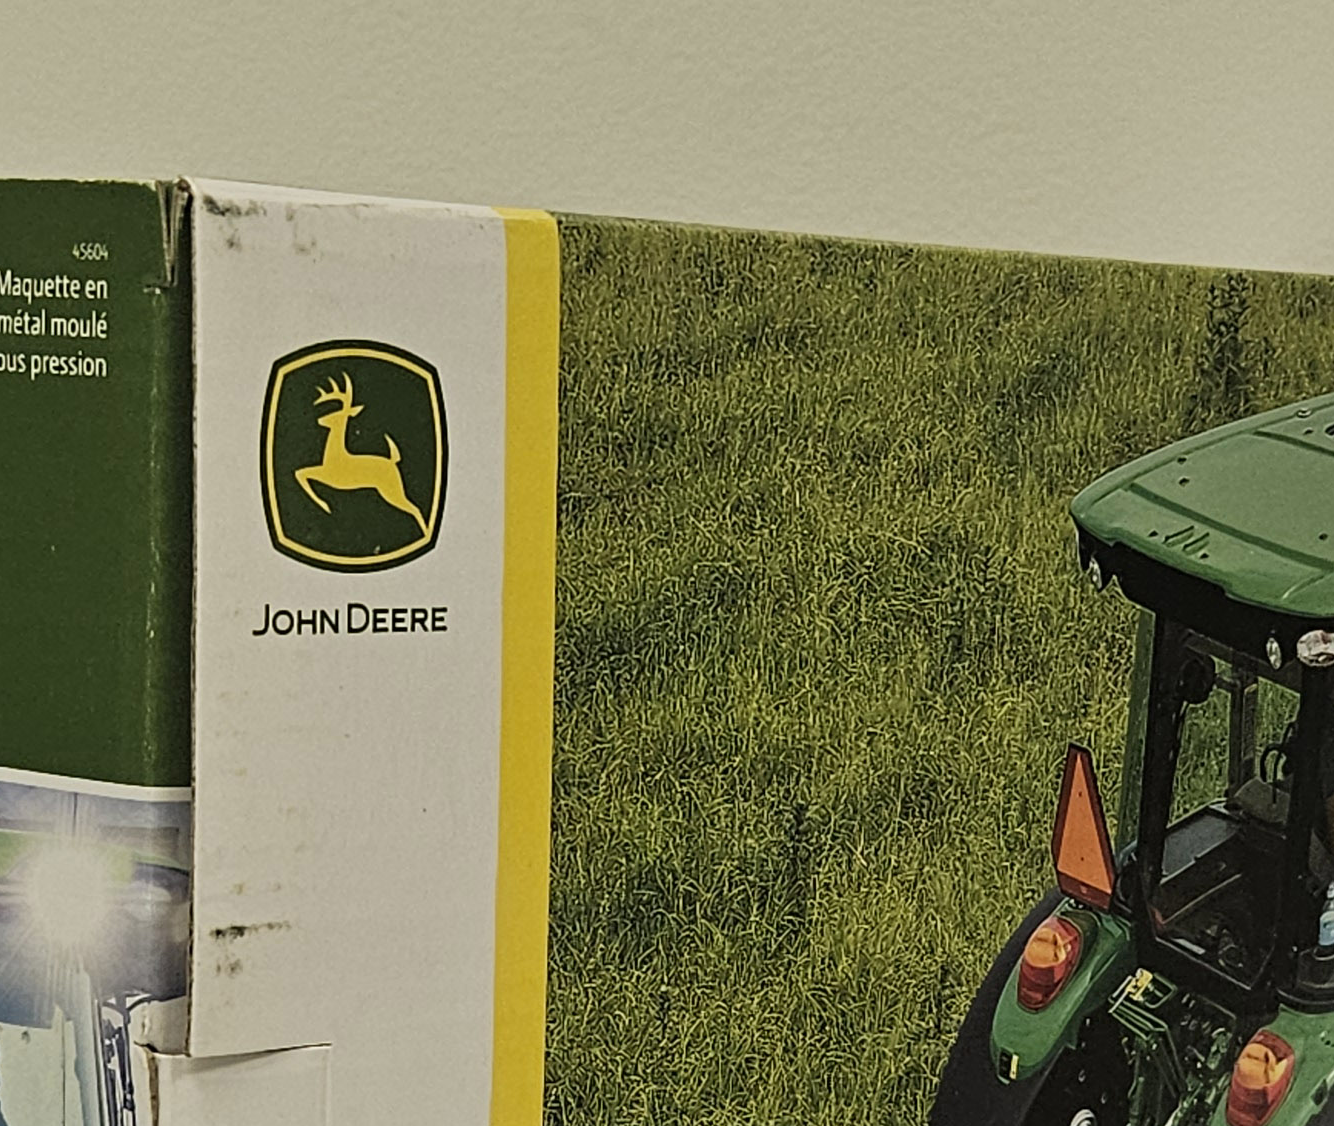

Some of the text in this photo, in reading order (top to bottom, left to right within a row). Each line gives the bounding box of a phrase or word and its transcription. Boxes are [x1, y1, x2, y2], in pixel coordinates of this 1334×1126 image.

[71, 242, 109, 261] 45604
[84, 279, 109, 299] en
[50, 310, 108, 339] moulé
[30, 350, 108, 382] pression
[251, 603, 449, 636] JOHN DEERE
